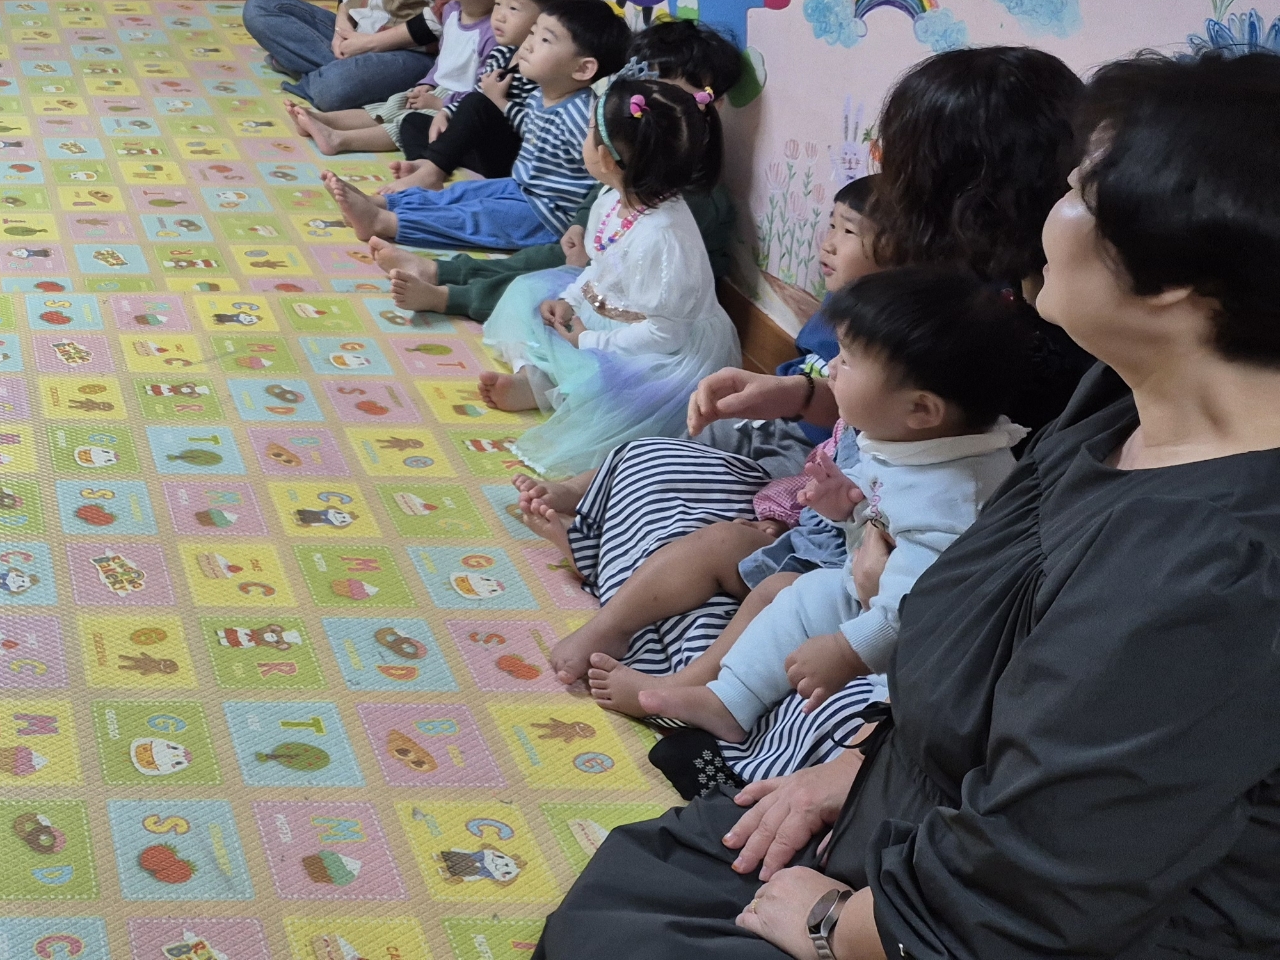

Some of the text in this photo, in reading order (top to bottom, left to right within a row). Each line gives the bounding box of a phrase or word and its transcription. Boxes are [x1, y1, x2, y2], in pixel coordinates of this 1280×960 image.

[44, 300, 72, 308] S
[232, 302, 260, 310] C
[247, 343, 277, 353] M
[163, 358, 193, 366] C
[437, 361, 467, 369] T
[337, 386, 367, 395] S
[173, 403, 204, 412] R
[265, 406, 297, 415] D
[186, 434, 221, 446] T
[80, 488, 115, 499] S
[204, 489, 242, 505] M
[317, 491, 353, 504] C
[0, 550, 34, 564] C
[338, 555, 382, 573] M
[460, 554, 495, 570] G
[239, 581, 276, 597] C
[130, 628, 167, 645] G
[468, 632, 506, 645] S
[9, 658, 47, 676] C
[257, 661, 298, 680] R
[375, 664, 419, 682] D
[13, 713, 59, 736] M
[146, 714, 188, 732] G
[280, 716, 327, 735] T
[413, 719, 459, 736] B
[573, 751, 615, 774] G
[142, 814, 190, 835] S
[310, 816, 367, 844] M
[465, 818, 514, 840] C
[31, 865, 74, 886] D
[33, 932, 84, 959] C
